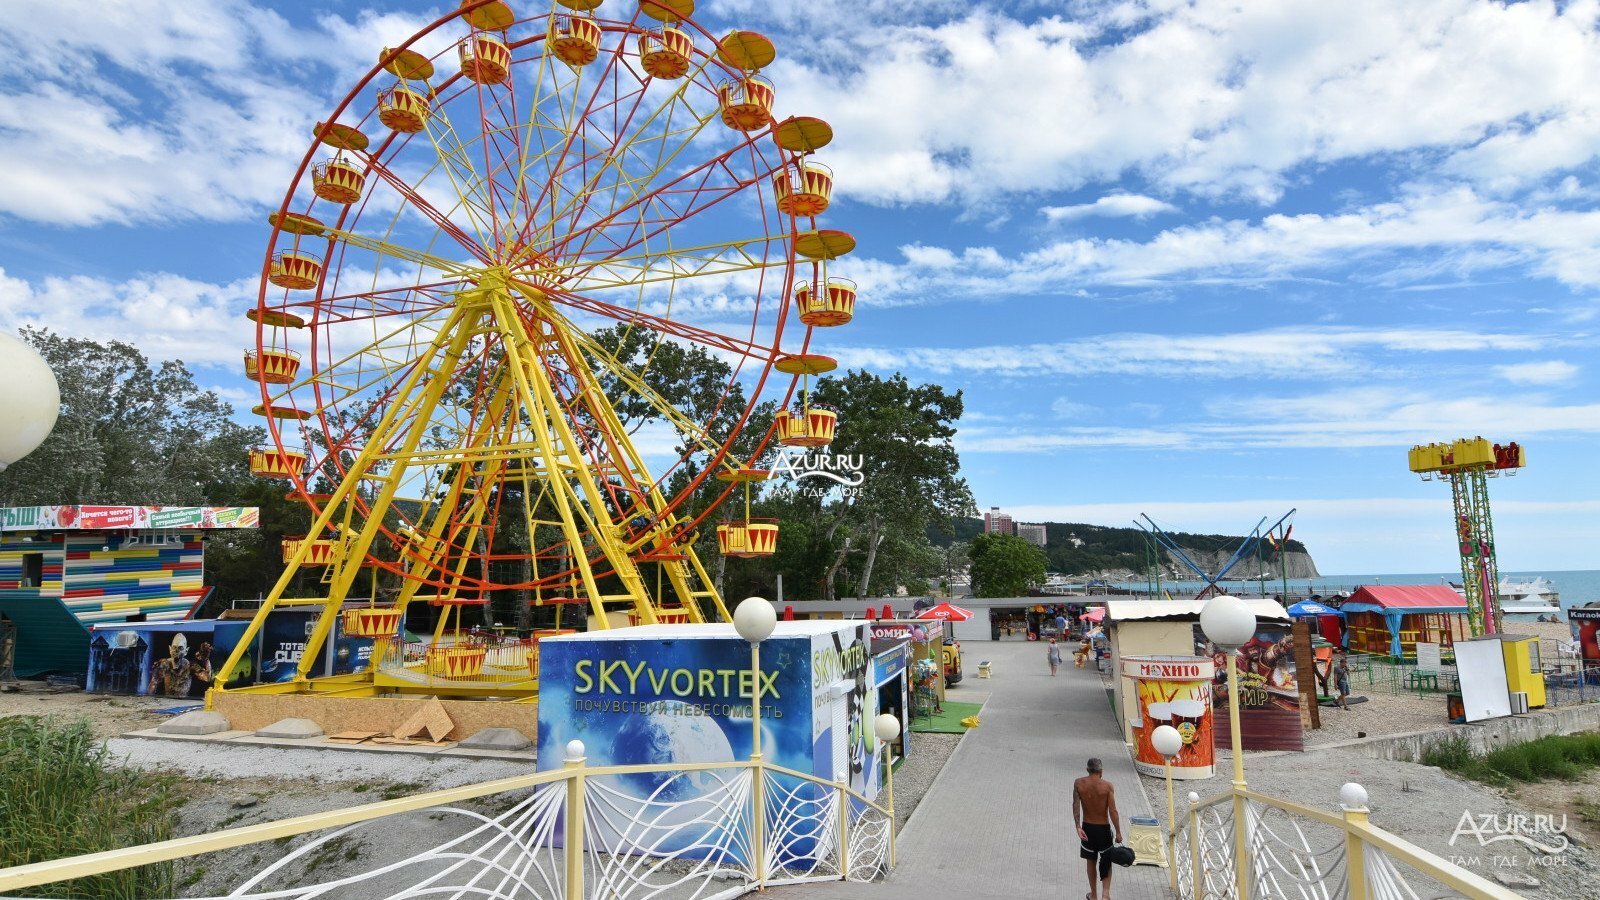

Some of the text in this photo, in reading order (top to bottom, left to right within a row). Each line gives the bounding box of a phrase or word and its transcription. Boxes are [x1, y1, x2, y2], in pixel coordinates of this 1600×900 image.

[80, 511, 108, 519] Хочется
[1140, 664, 1200, 677] МОХИТО
[574, 659, 781, 700] SKYVORTEX
[575, 699, 668, 716] ПОЧУВСТВУЙ
